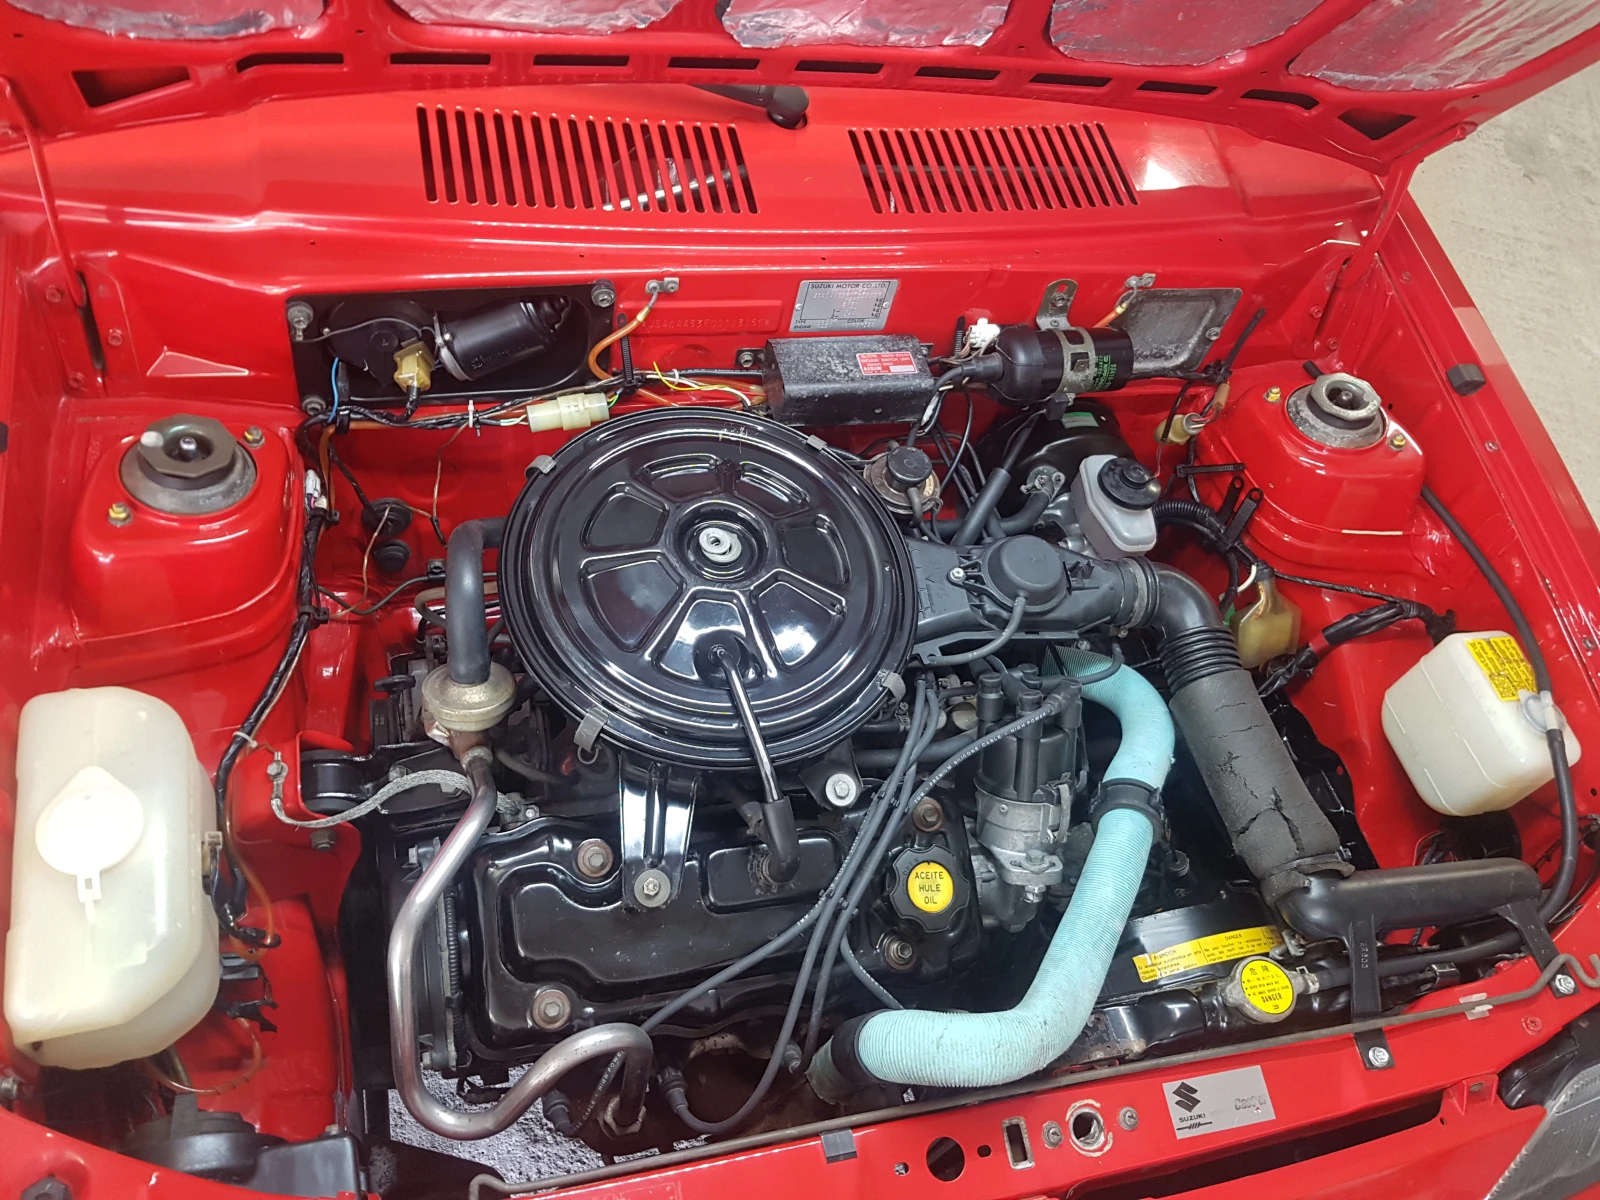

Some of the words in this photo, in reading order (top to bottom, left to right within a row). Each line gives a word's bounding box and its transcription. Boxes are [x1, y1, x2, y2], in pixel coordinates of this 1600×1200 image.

[929, 765, 952, 787] PREMIUM
[953, 746, 979, 765] SILICONE
[981, 734, 1002, 748] CABLE
[1010, 723, 1026, 733] HIGH
[1026, 712, 1047, 726] POWER
[914, 871, 944, 880] ACEITE
[918, 883, 941, 892] HULE
[924, 896, 938, 905] OIL
[1261, 992, 1283, 1003] DANGER
[597, 1073, 609, 1091] HIGH
[1179, 1112, 1206, 1123] SUZUKI
